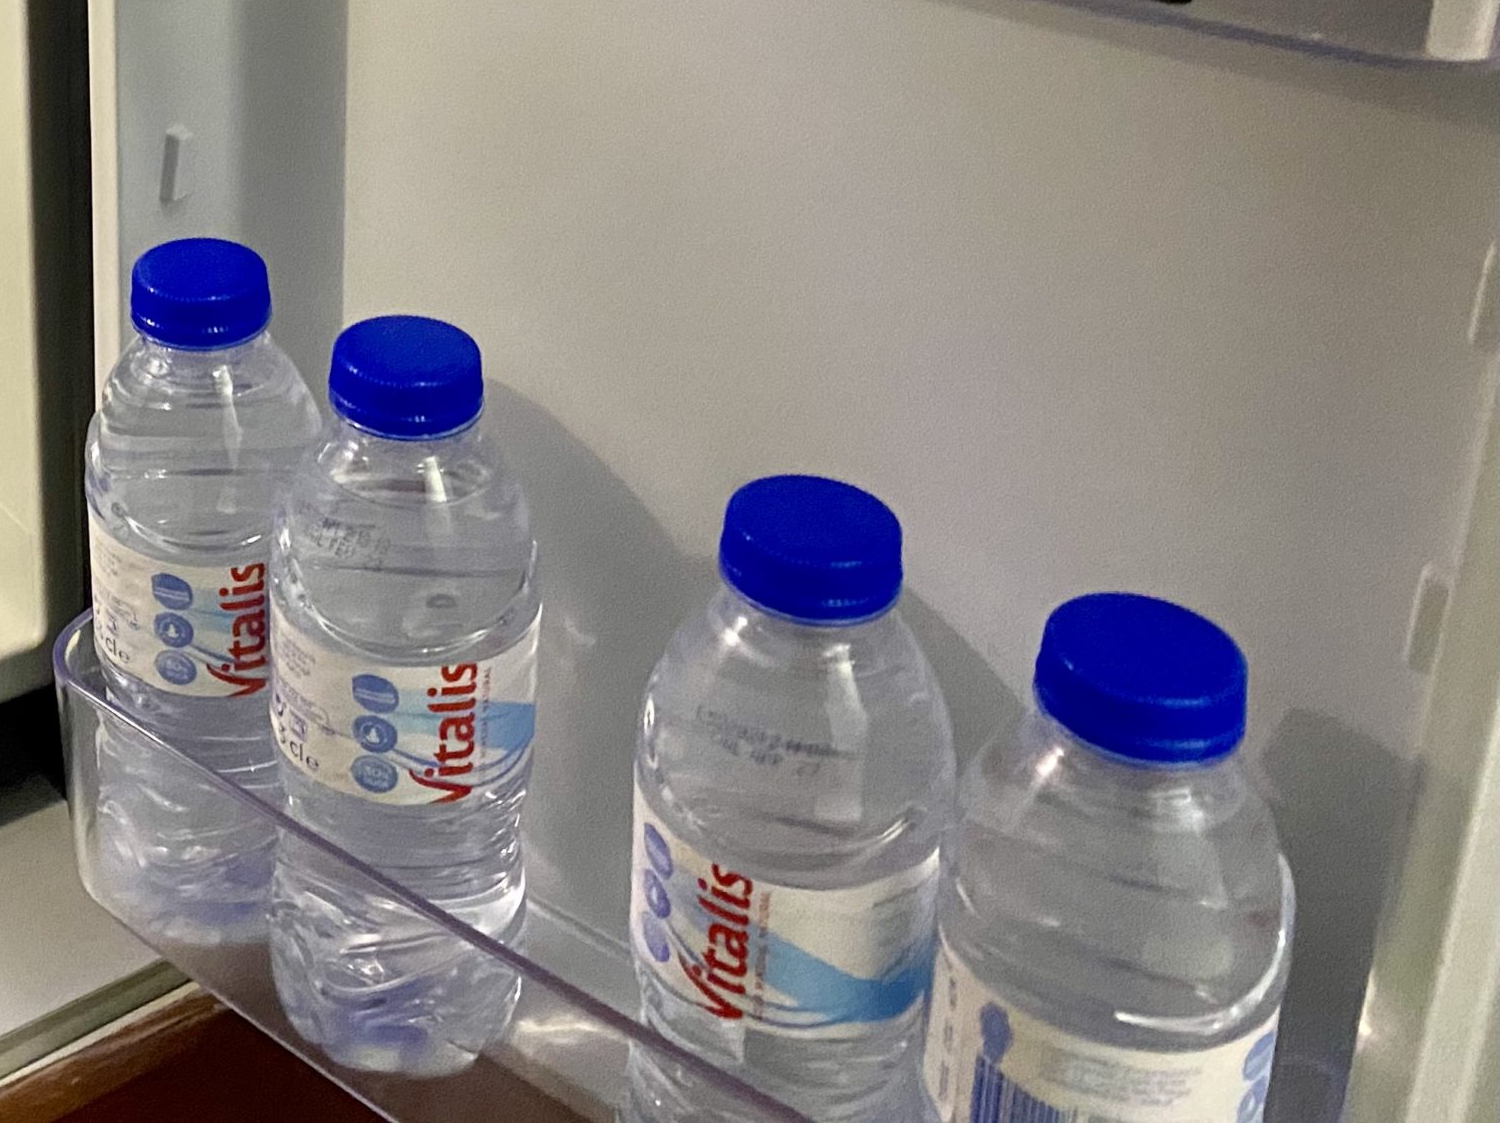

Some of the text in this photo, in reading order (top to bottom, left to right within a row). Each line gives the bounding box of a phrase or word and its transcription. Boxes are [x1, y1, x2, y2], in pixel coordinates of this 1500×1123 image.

[205, 562, 267, 698] Vitalis
[408, 662, 479, 804] Vitalis
[676, 862, 754, 1021] Vitalis
